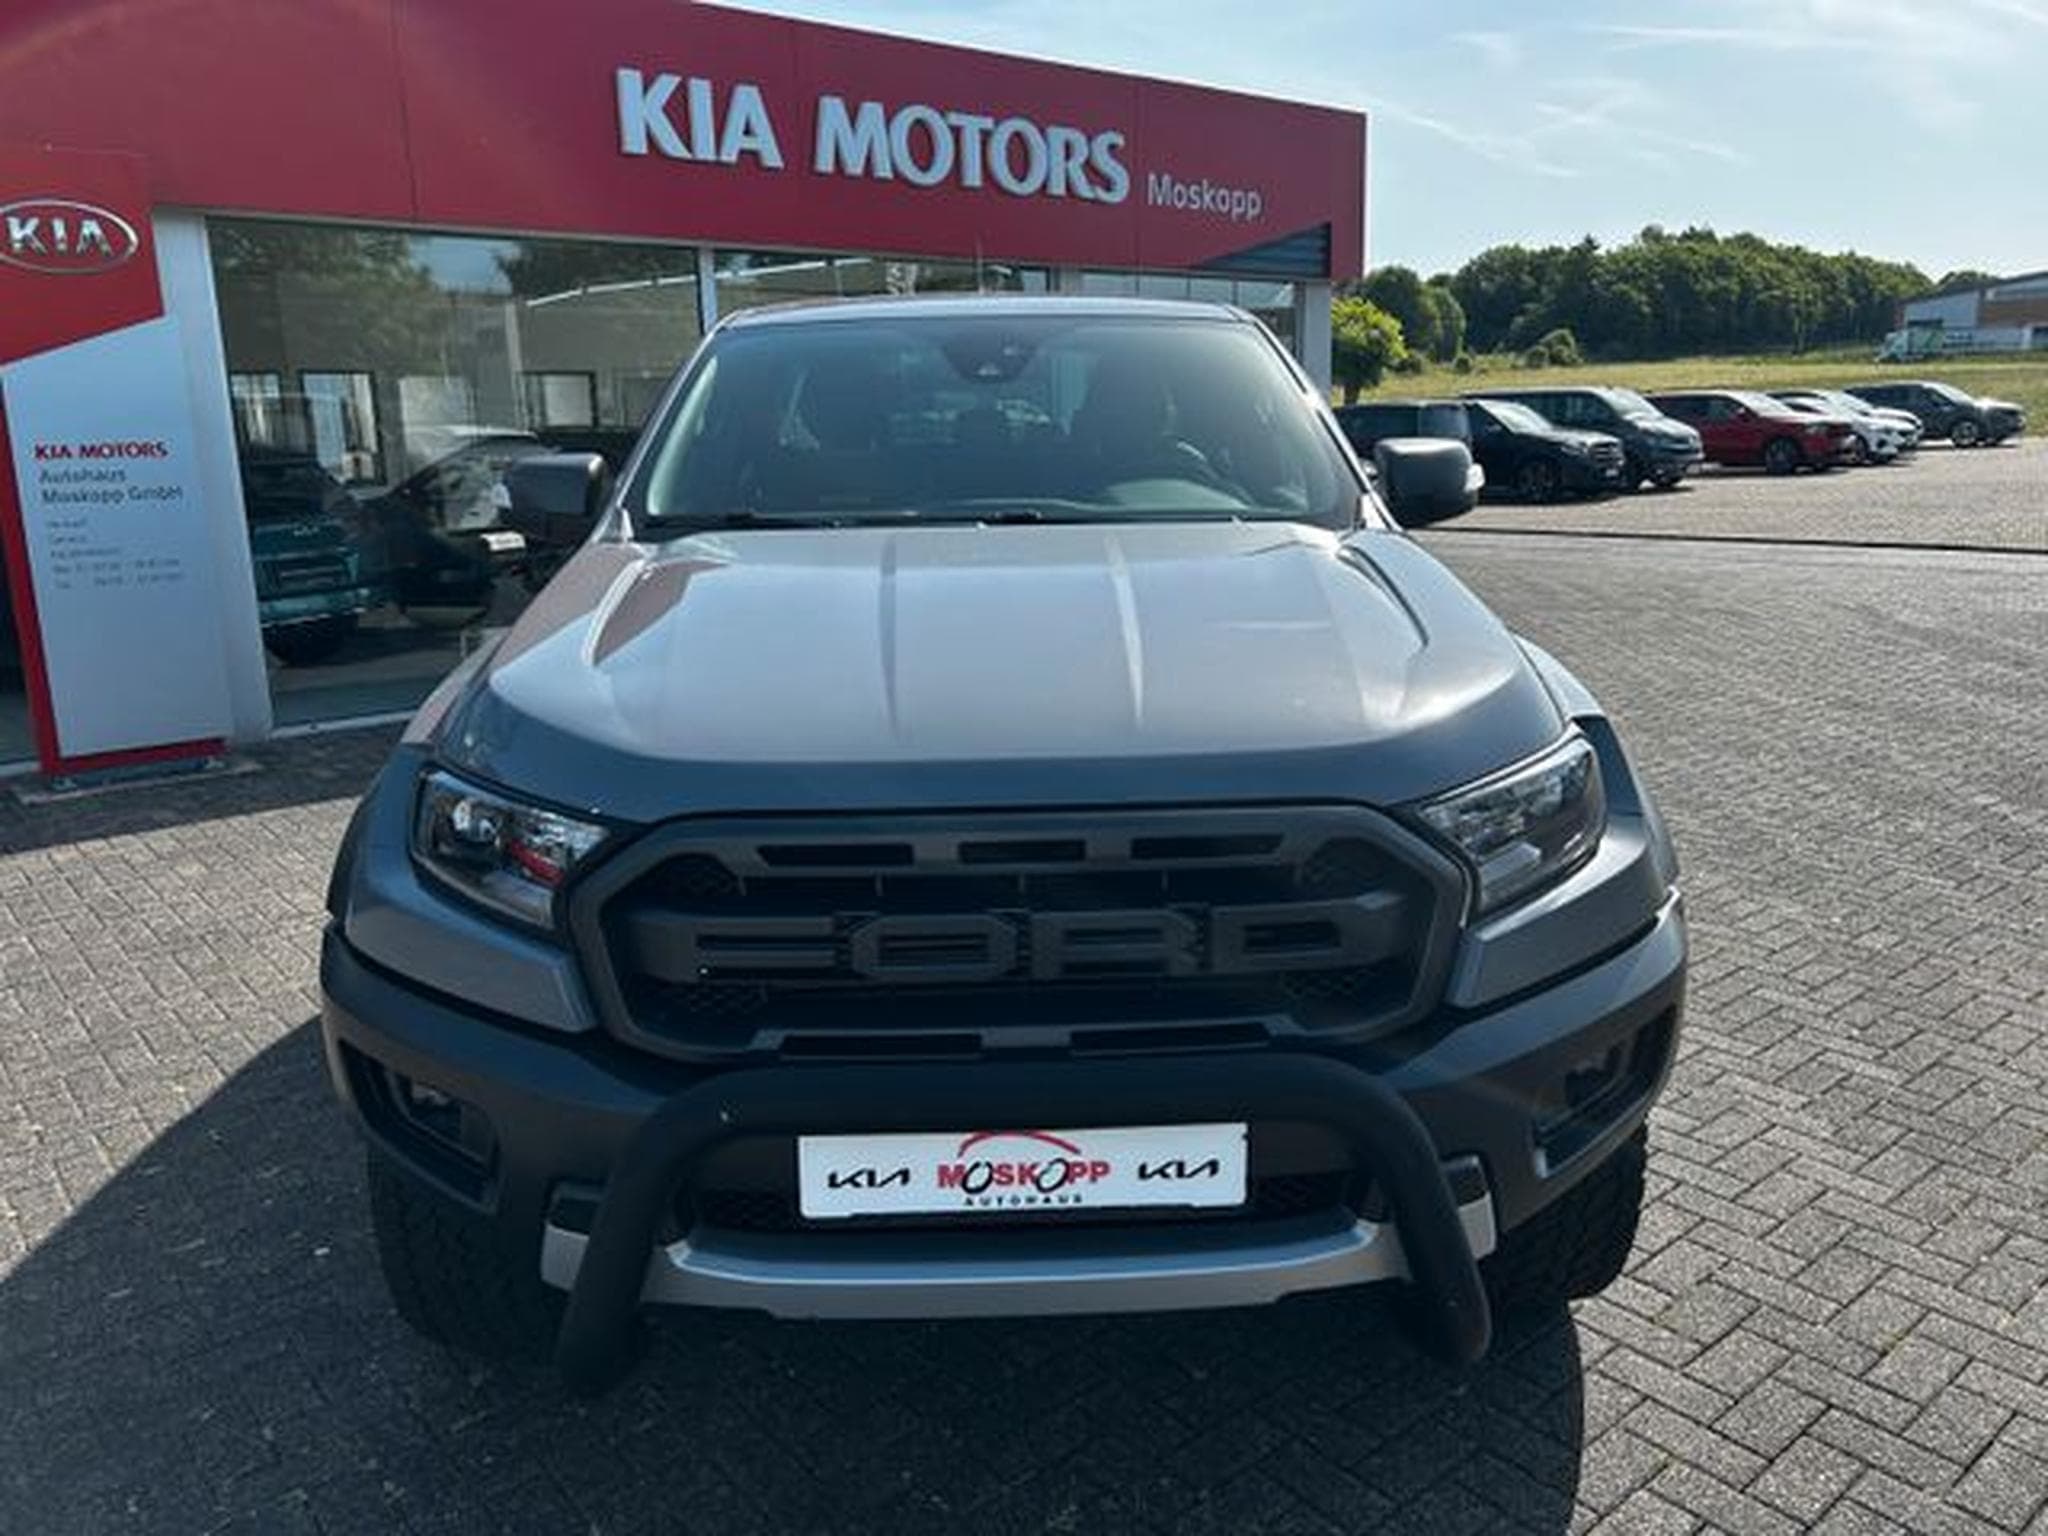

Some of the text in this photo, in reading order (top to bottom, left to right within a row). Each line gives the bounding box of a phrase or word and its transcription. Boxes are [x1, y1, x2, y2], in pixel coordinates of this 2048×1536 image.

[616, 68, 1130, 204] KIA MOTORS
[1147, 172, 1263, 220] Moskopp
[5, 216, 113, 255] KIA
[35, 441, 168, 459] KIA MOTORS
[39, 468, 126, 483] Autohaus
[42, 485, 183, 504] Moskopp GmbH
[630, 897, 1398, 984] FORD
[827, 1167, 911, 1189] KIA
[937, 1158, 1111, 1194] MOSKOPP
[1137, 1159, 1220, 1181] KIA
[963, 1194, 1084, 1207] AUTOHAUS
